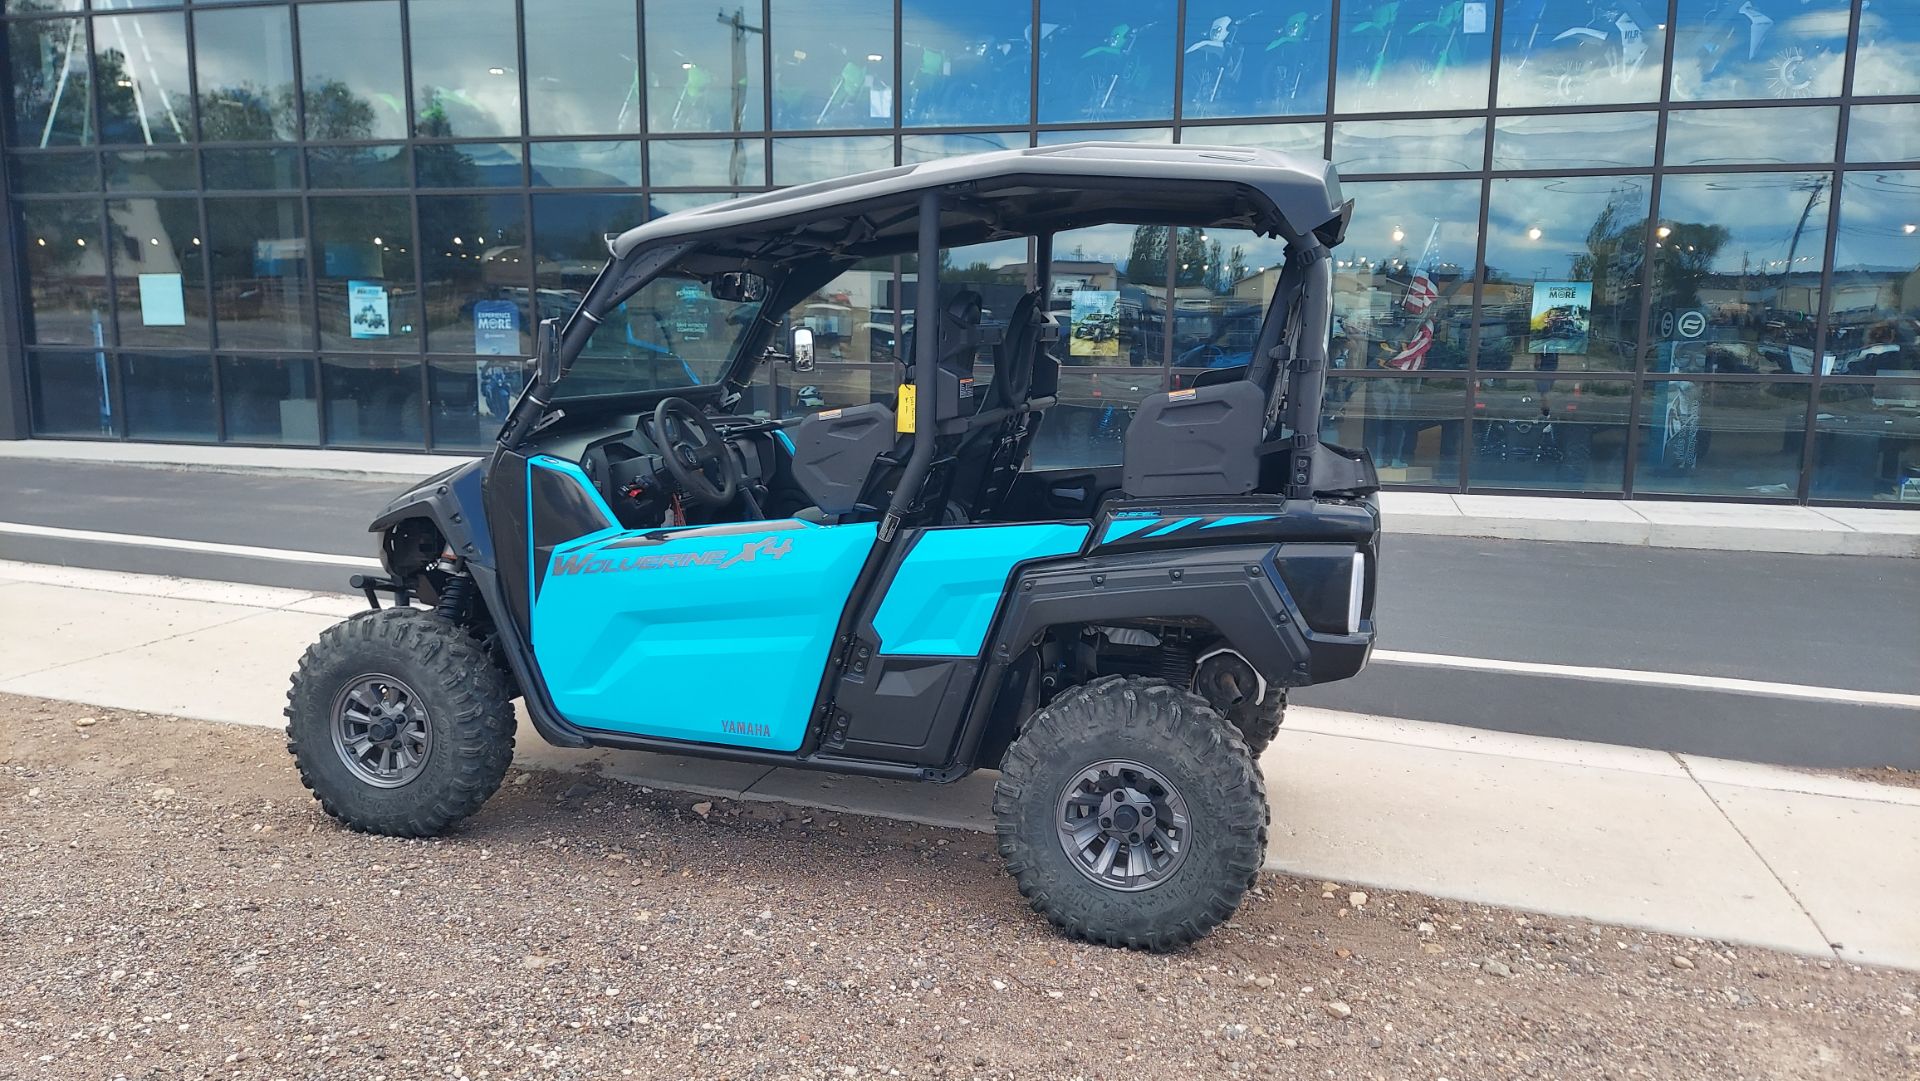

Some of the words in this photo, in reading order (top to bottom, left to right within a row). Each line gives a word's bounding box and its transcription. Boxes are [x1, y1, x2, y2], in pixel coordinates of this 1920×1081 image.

[478, 319, 512, 330] MORE
[552, 551, 728, 576] WOLVERINE
[717, 536, 793, 569] X4
[721, 719, 771, 737] YAMAHA
